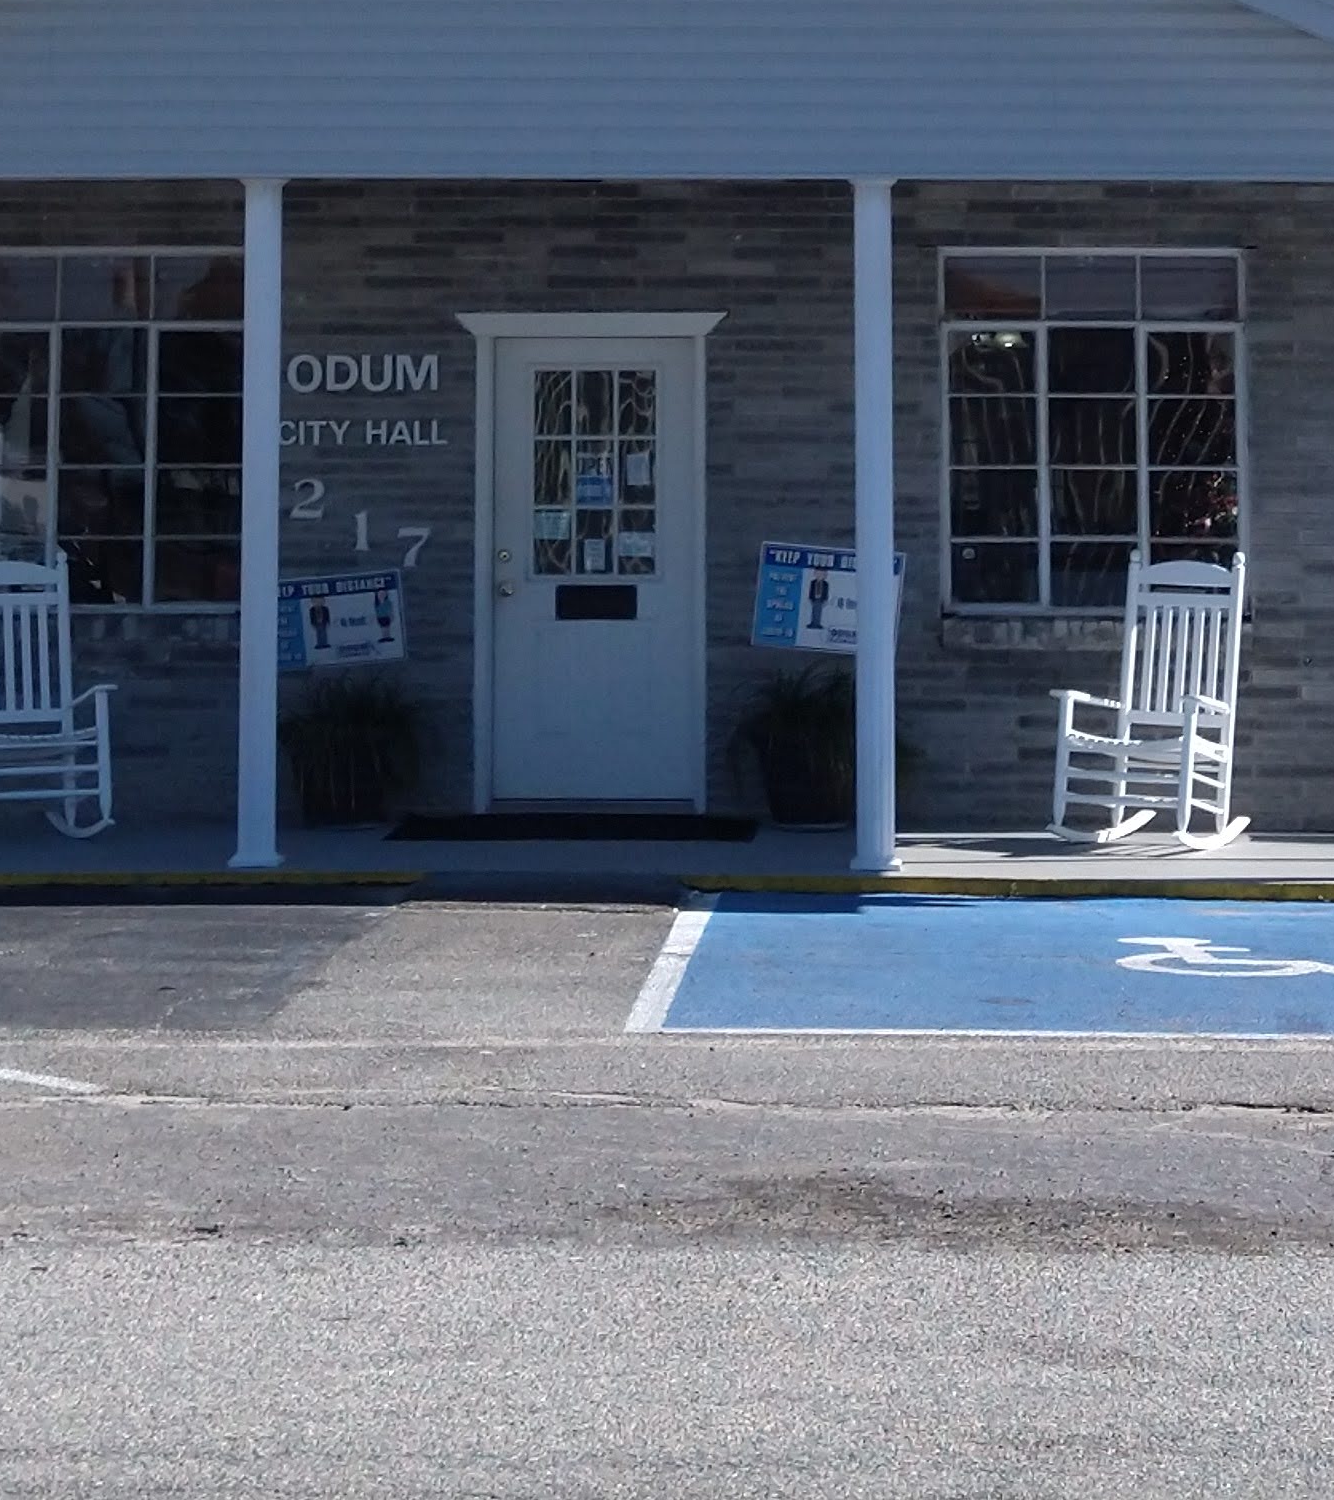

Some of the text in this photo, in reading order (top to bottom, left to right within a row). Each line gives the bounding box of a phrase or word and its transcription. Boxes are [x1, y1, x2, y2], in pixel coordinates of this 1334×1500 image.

[286, 353, 439, 394] ODUM
[279, 419, 449, 446] CITY HALL
